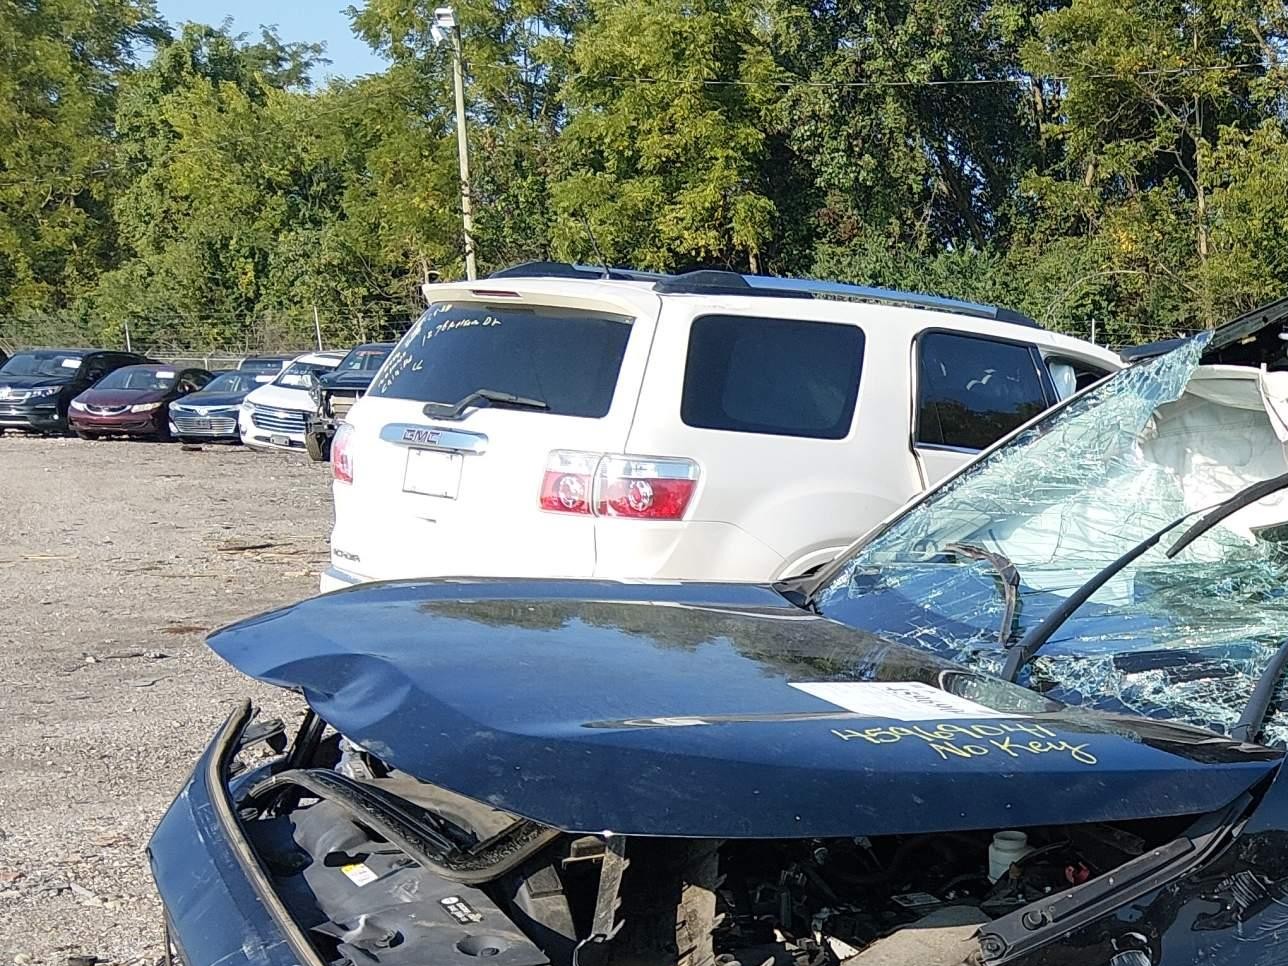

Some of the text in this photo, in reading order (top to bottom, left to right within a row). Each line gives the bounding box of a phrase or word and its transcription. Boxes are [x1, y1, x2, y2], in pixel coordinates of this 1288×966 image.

[403, 428, 441, 445] GMC
[830, 723, 1057, 744] 45969041
[928, 736, 1098, 765] No Key
